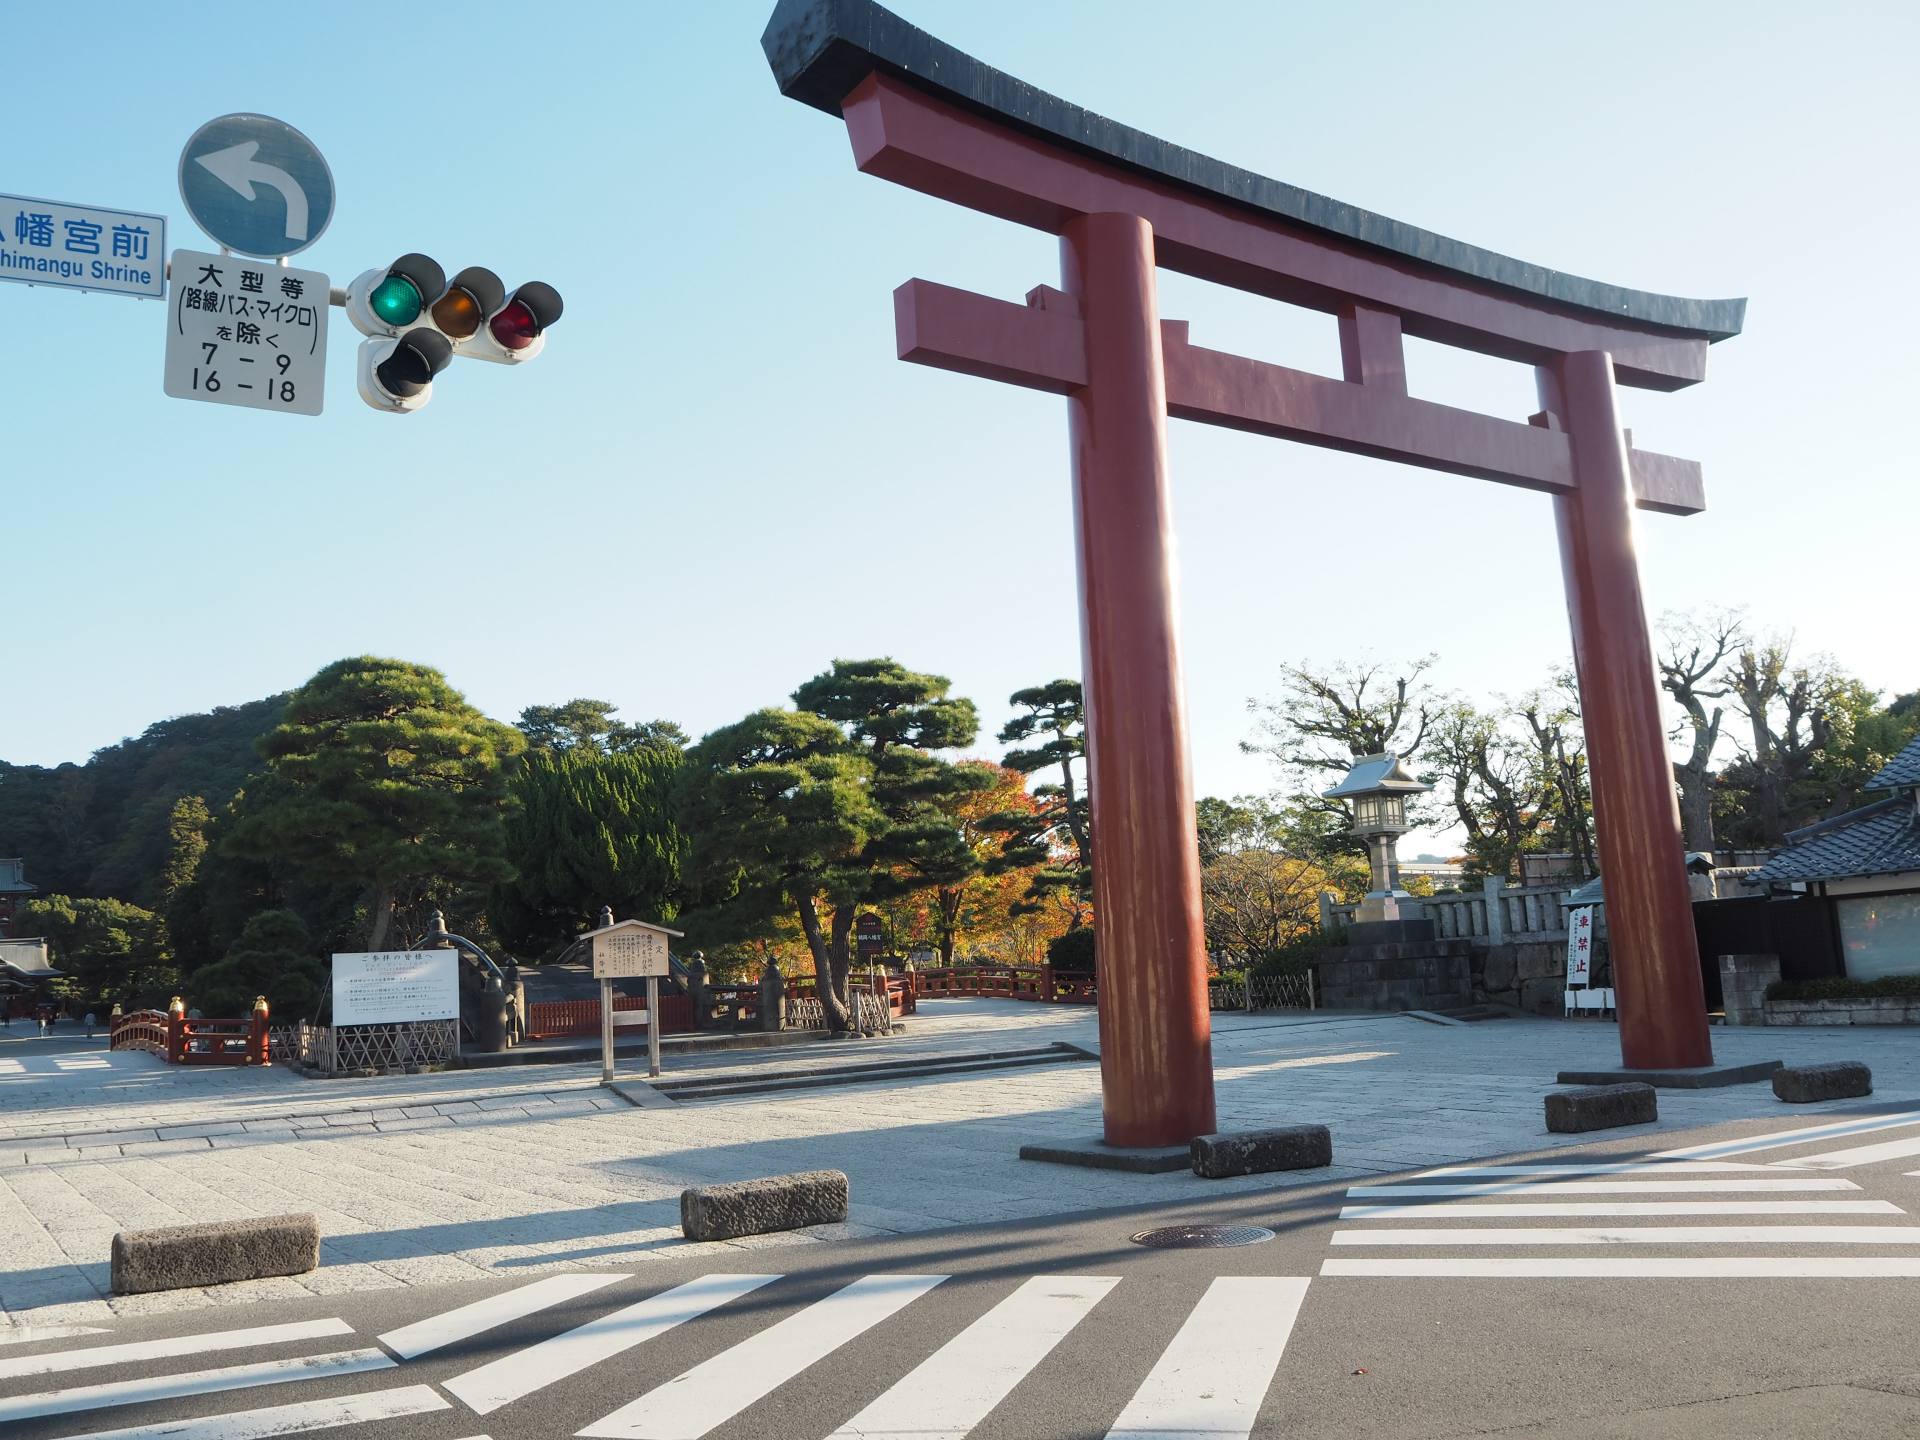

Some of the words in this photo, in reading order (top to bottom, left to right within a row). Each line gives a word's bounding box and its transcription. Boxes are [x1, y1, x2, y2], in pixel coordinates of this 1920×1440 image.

[90, 260, 152, 285] Shrine
[197, 264, 304, 299] 大型等
